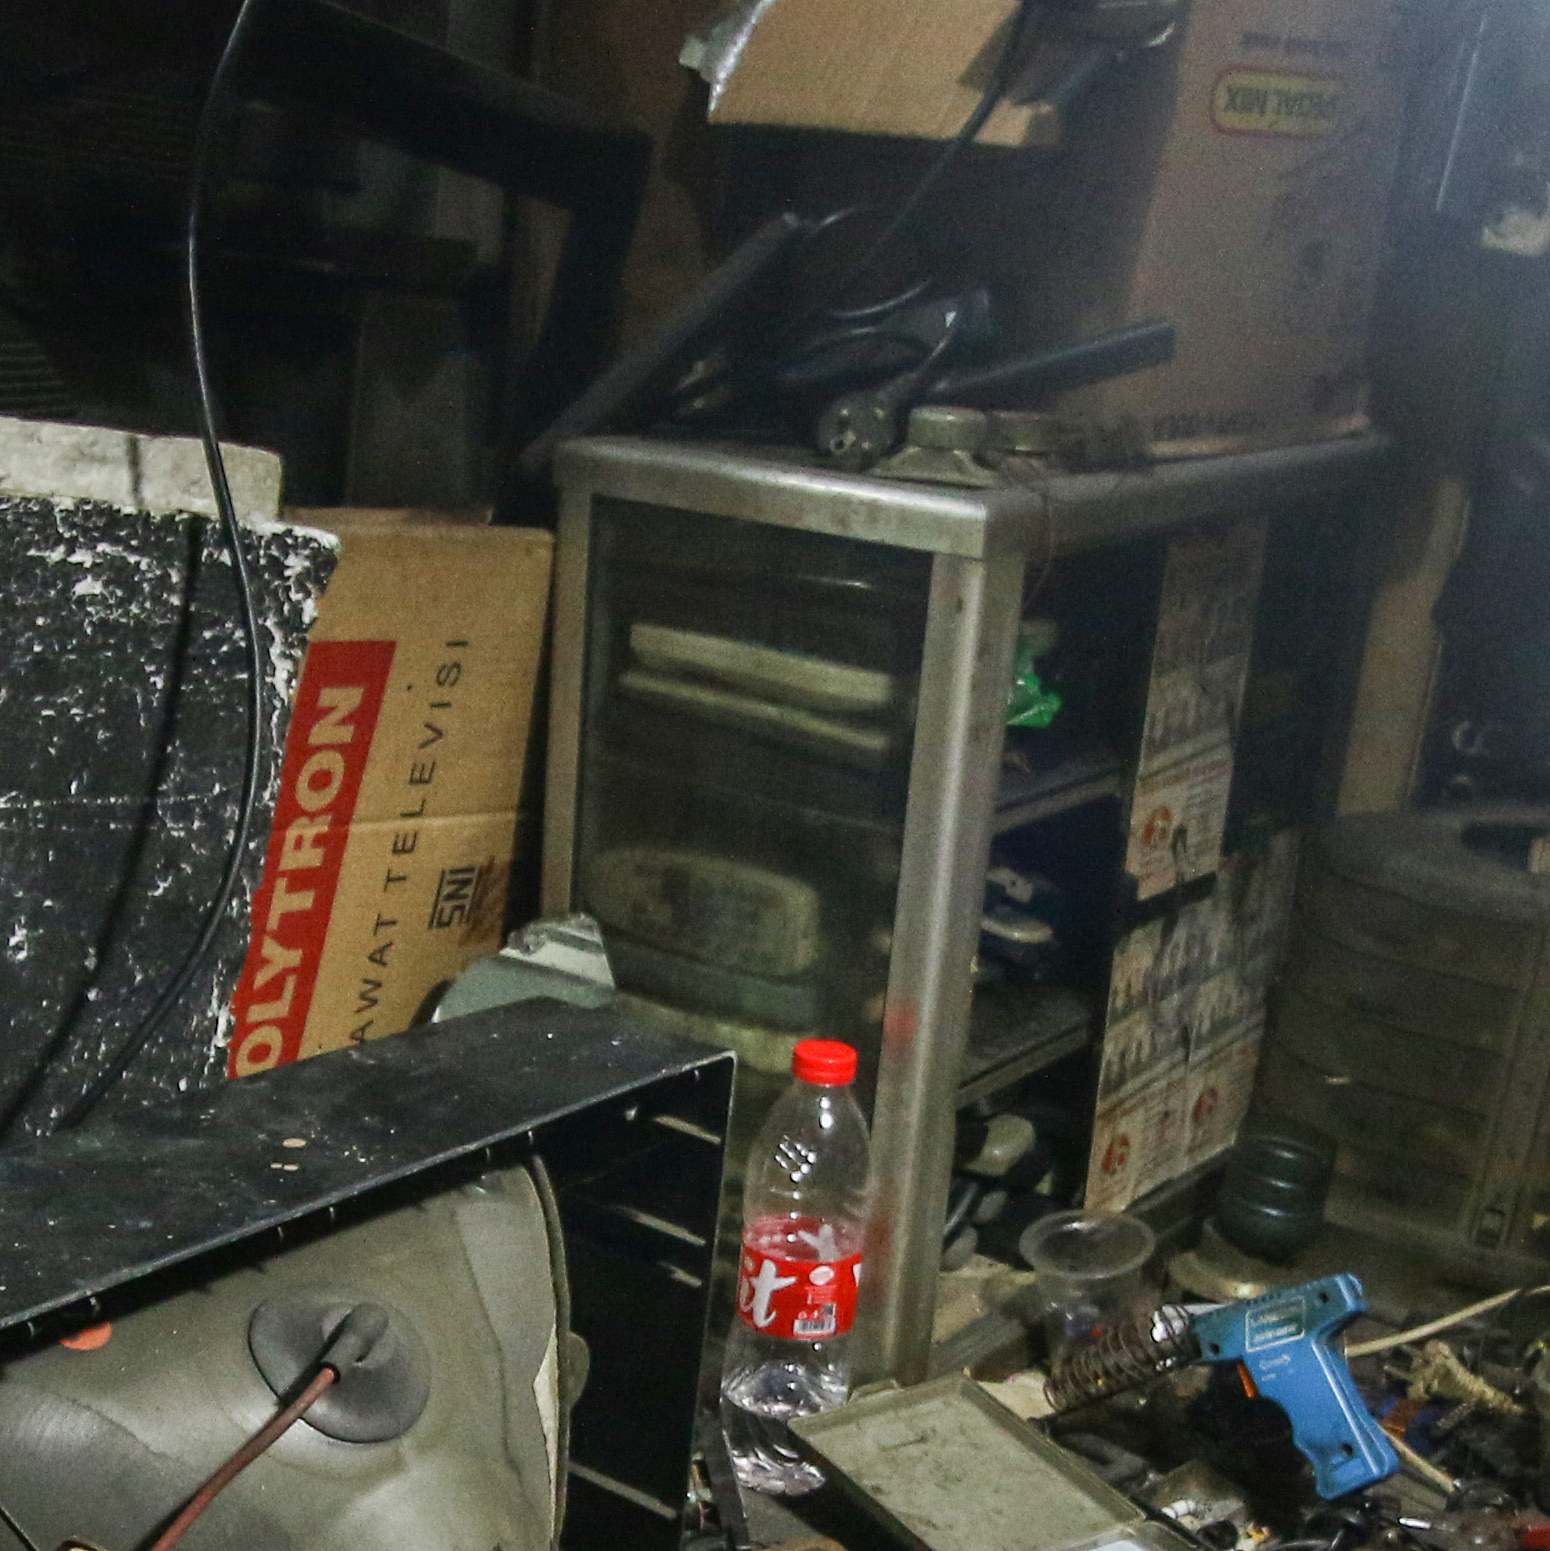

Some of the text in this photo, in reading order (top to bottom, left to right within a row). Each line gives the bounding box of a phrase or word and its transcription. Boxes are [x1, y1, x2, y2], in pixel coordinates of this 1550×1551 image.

[236, 685, 365, 1078] OLYTRON
[351, 639, 470, 1044] AWAT TELEVISI
[436, 865, 478, 930] SNI
